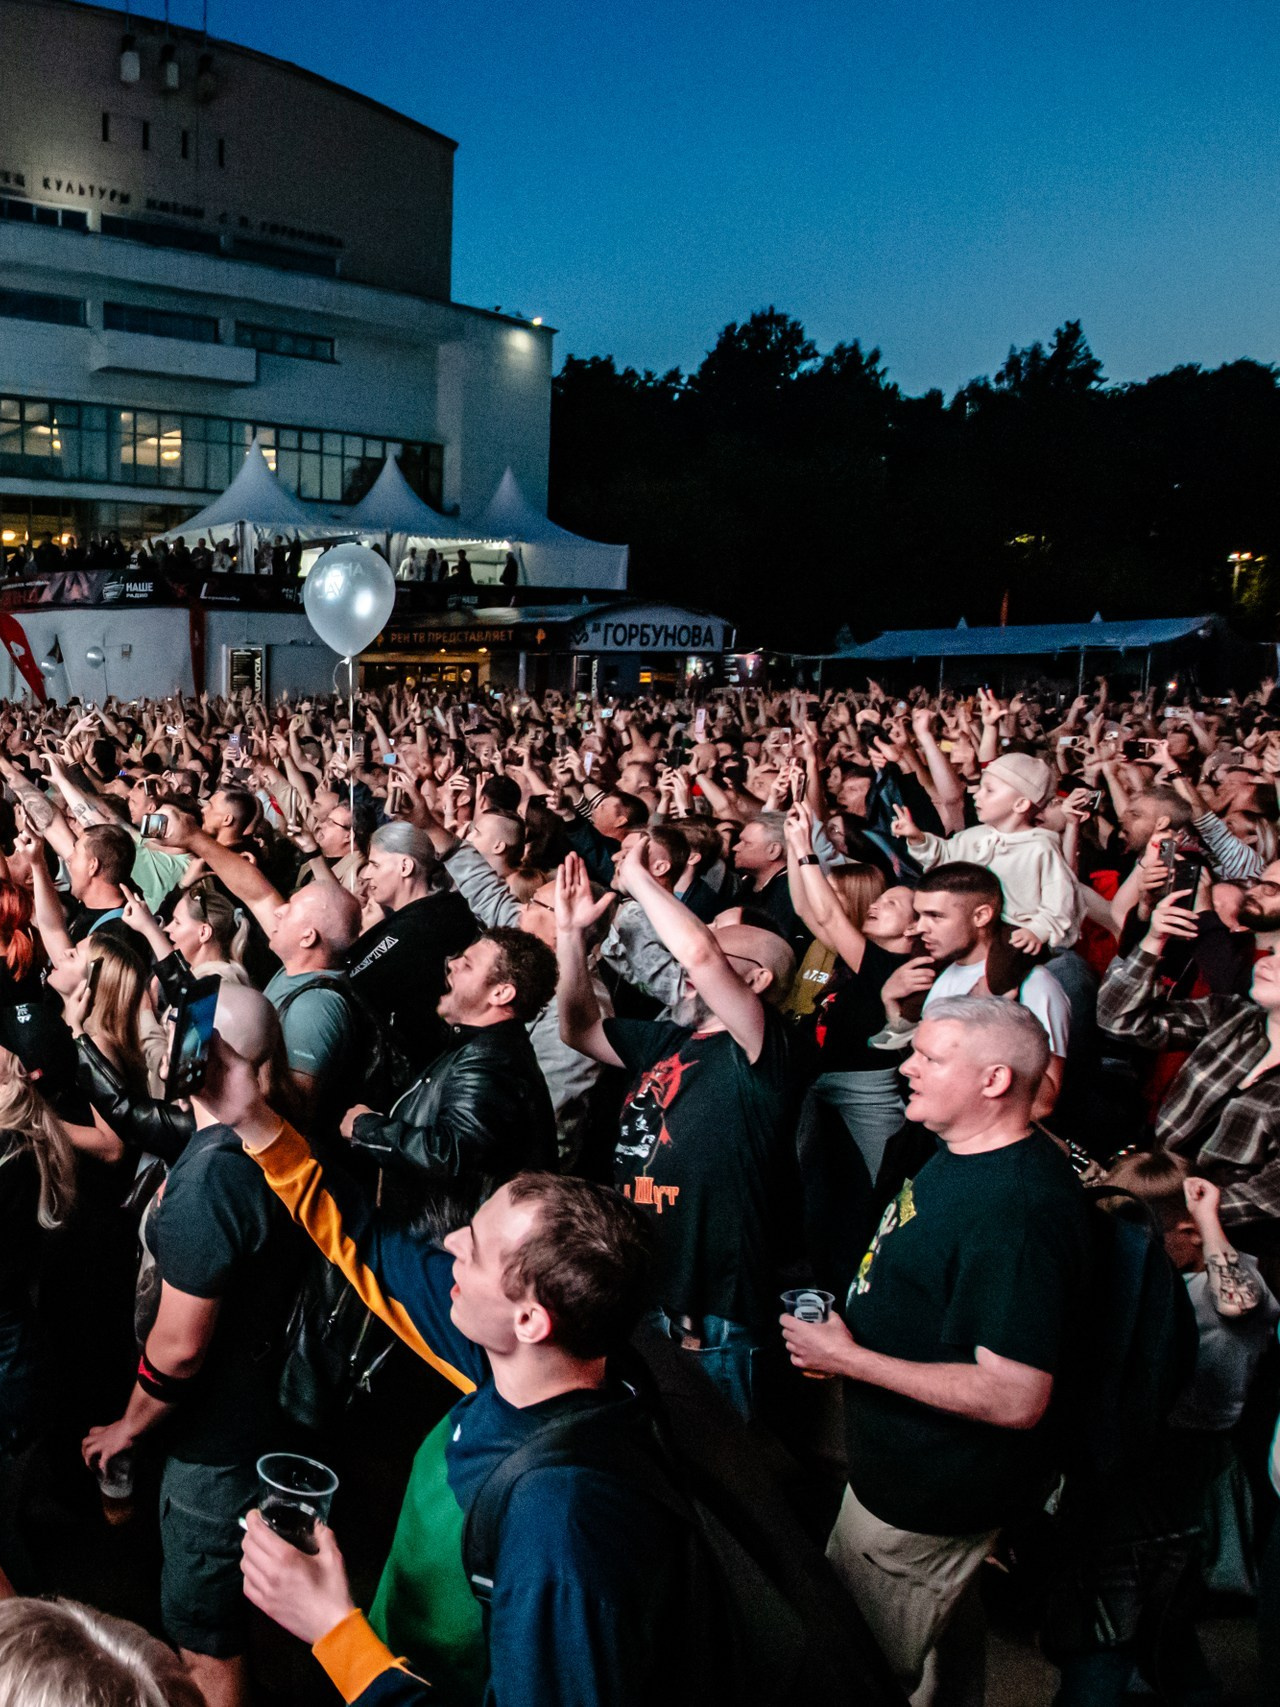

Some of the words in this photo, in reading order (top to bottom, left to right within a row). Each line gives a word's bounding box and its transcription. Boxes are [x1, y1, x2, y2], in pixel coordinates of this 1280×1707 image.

[41, 176, 131, 205] КУЛЬТУРЫ
[125, 580, 154, 592] НАШЕ
[391, 632, 410, 643] РЕН
[412, 632, 425, 642] ТВ
[427, 630, 514, 643] ПРЕДСТАВЛЯЕТ
[603, 623, 714, 647] ГОРБУНОВА
[254, 656, 262, 692] ВГУСТА
